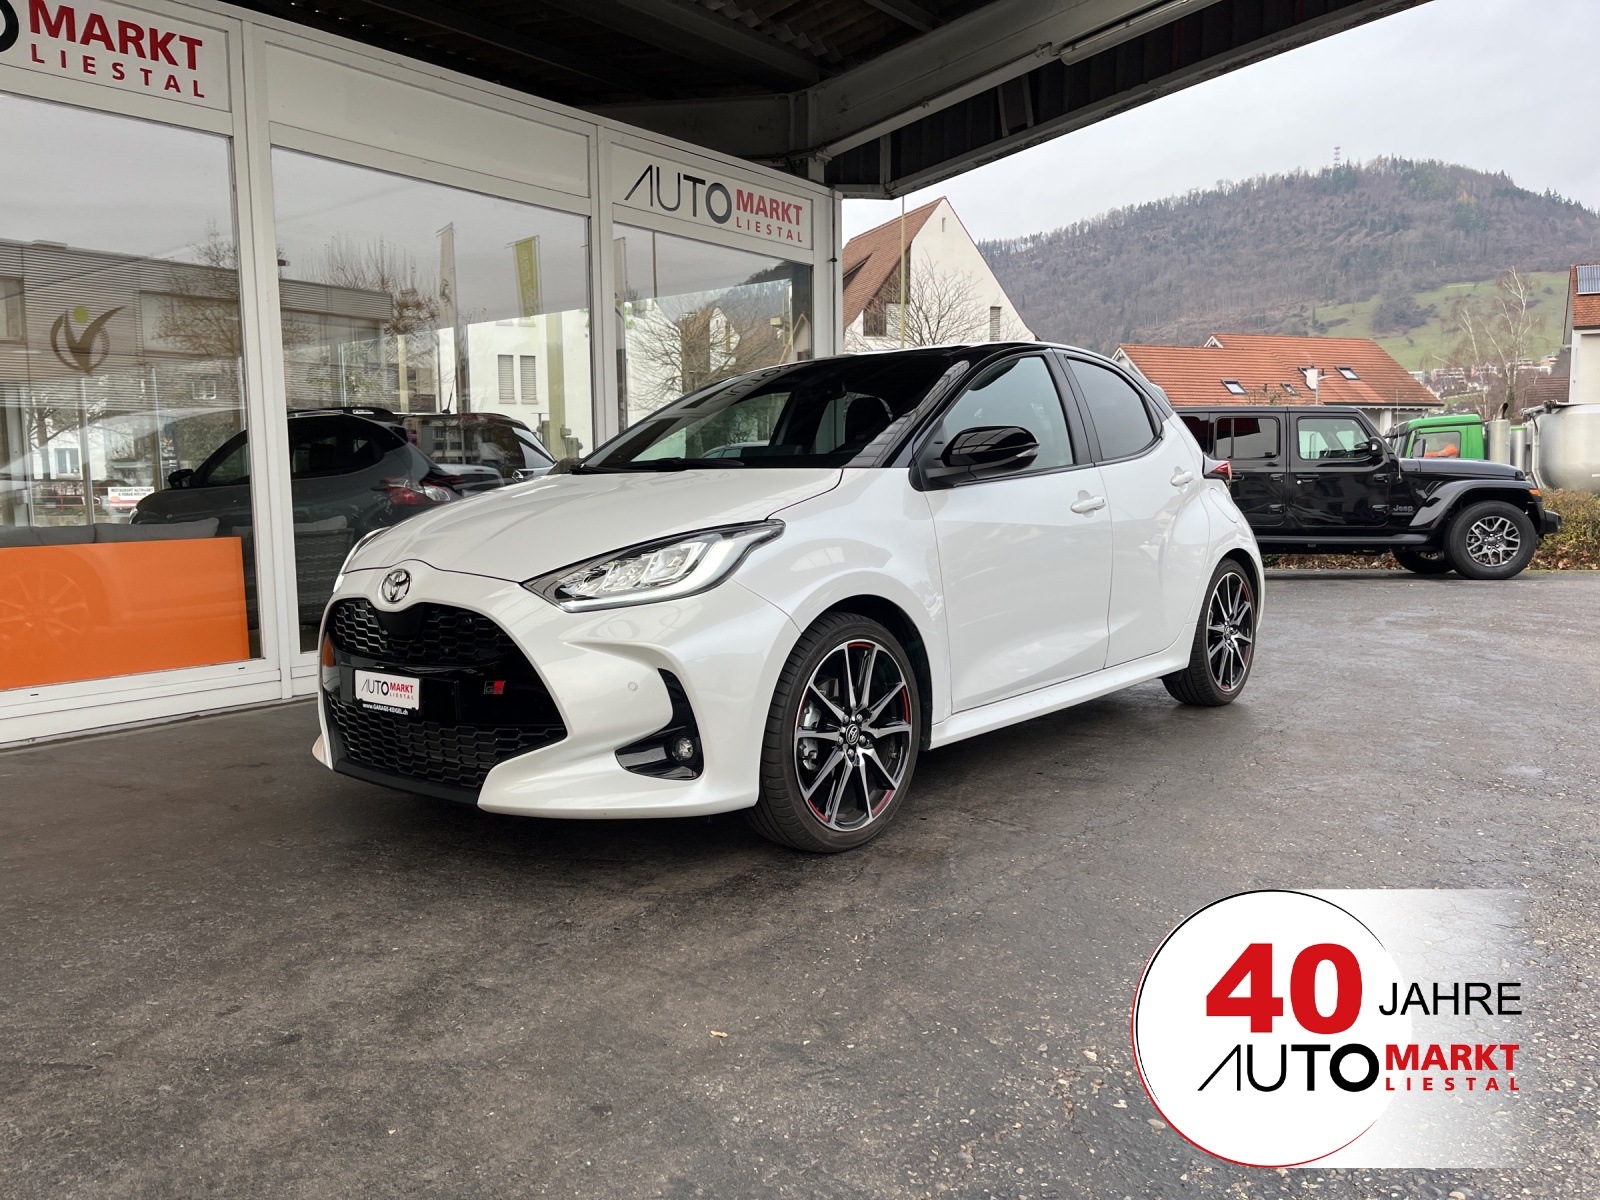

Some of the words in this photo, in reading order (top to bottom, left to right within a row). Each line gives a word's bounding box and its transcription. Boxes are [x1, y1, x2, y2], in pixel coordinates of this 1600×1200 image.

[28, 0, 203, 71] MARKT
[31, 43, 205, 98] LIESTAL
[624, 164, 733, 224] AUTO
[736, 188, 803, 226] MARKT
[736, 216, 803, 243] LIESTAL
[1393, 504, 1413, 512] Jeep
[361, 678, 389, 696] AUTO
[390, 682, 414, 694] MARKT
[390, 692, 414, 700] LIESTAL
